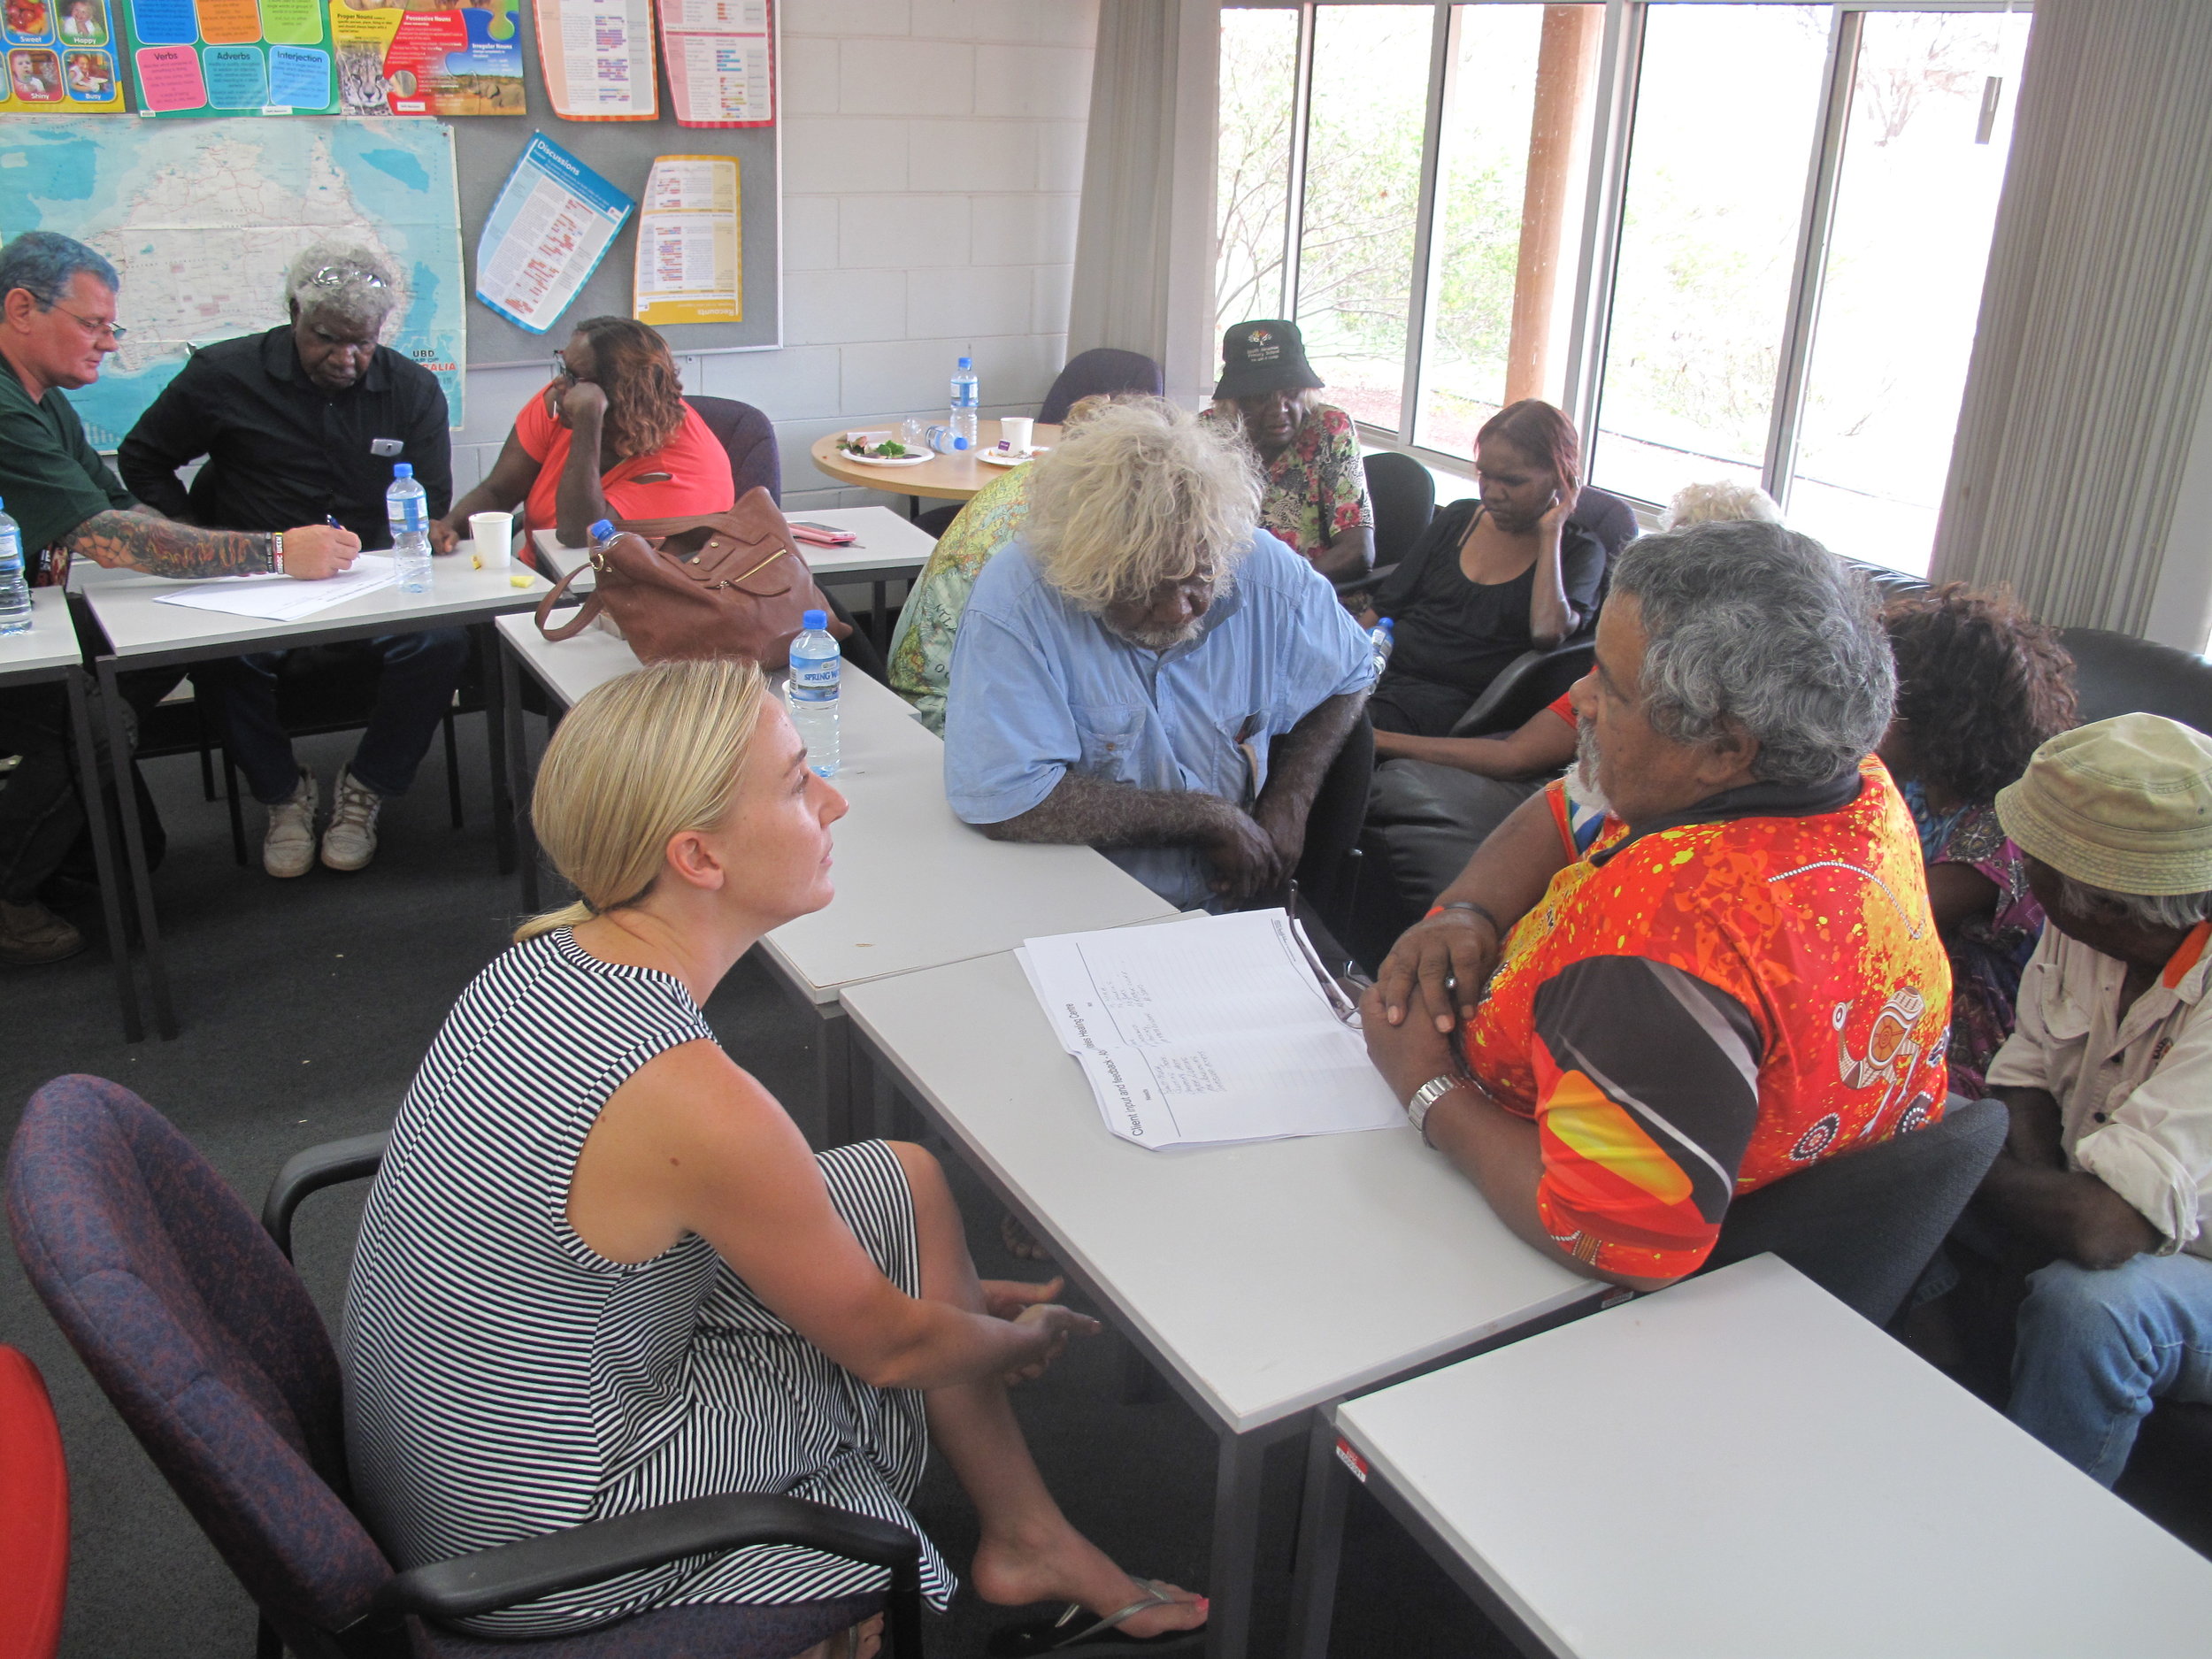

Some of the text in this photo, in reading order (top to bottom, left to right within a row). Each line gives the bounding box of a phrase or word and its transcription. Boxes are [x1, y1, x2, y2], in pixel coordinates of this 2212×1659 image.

[154, 51, 179, 61] Verbs
[217, 51, 250, 60] Adverbs
[277, 50, 323, 64] Interjection
[537, 141, 580, 176] Discussions
[804, 672, 831, 680] SPRING
[1073, 1018, 1089, 1038] Healing
[1102, 1059, 1123, 1084] feedback
[1117, 1084, 1129, 1096] and
[1121, 1096, 1136, 1114] input
[1128, 1113, 1144, 1137] Client
